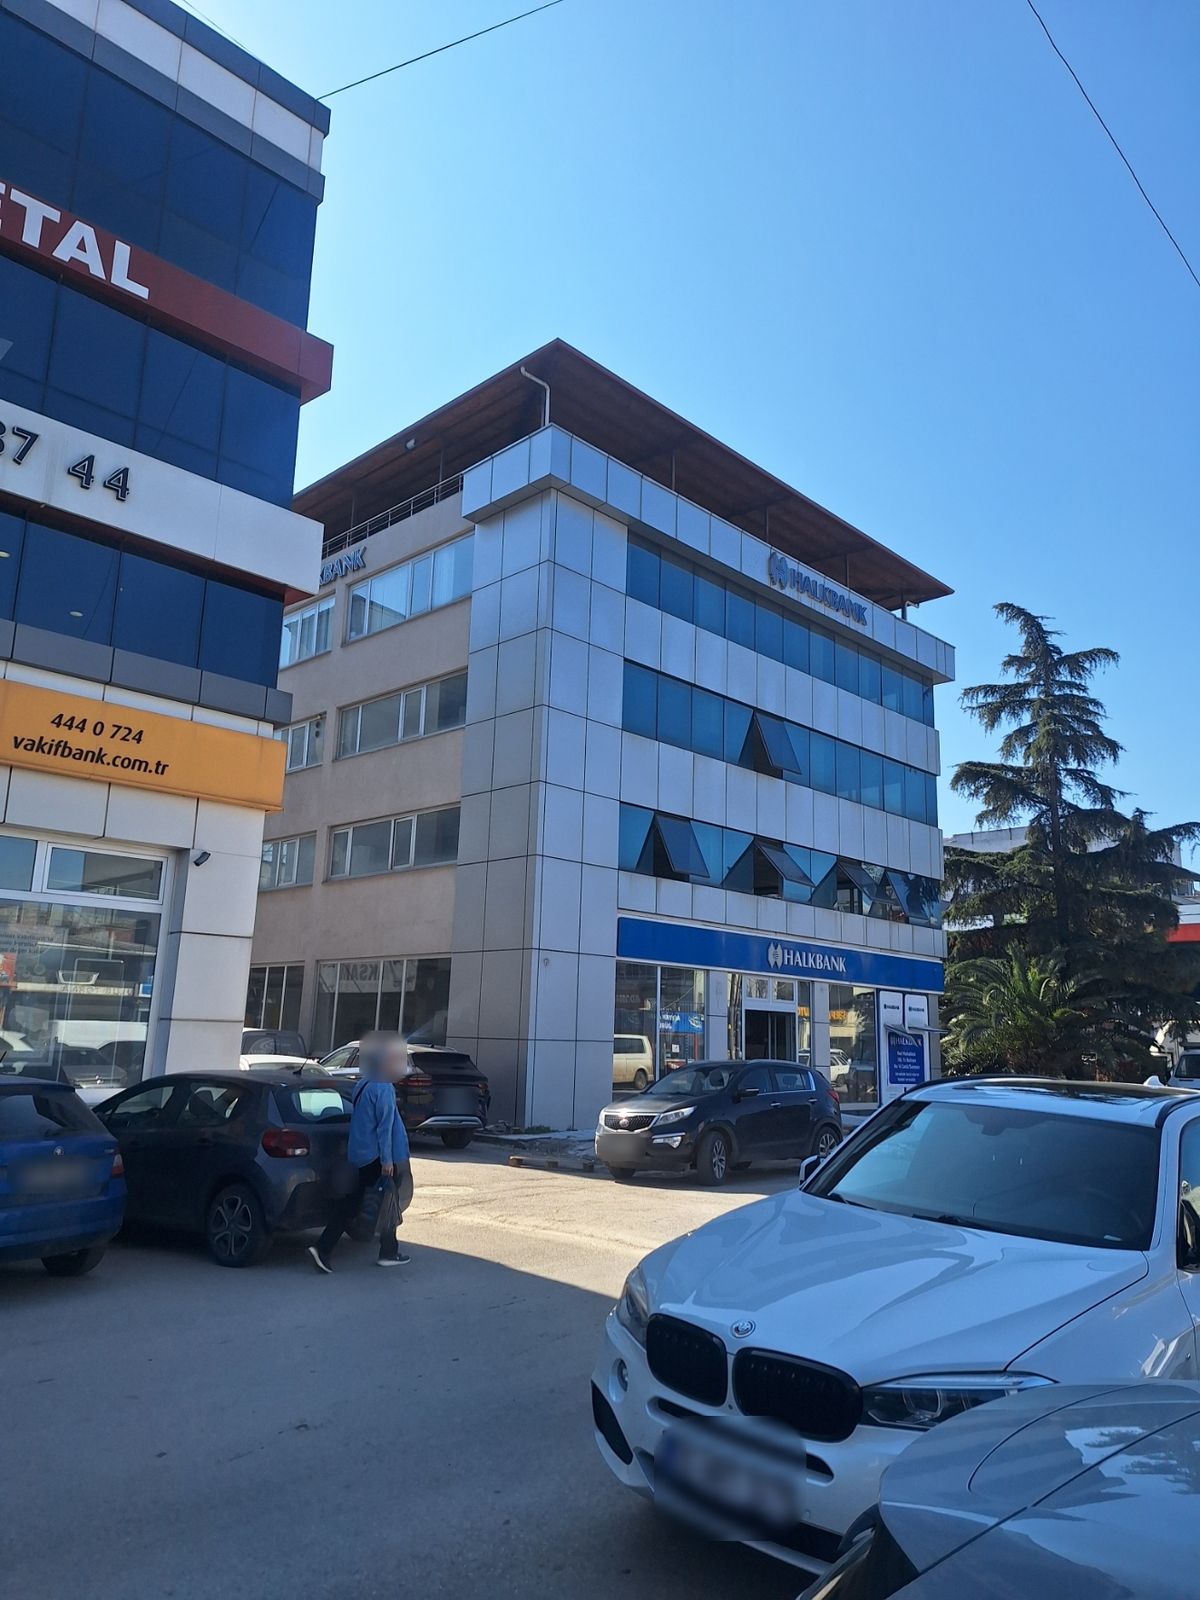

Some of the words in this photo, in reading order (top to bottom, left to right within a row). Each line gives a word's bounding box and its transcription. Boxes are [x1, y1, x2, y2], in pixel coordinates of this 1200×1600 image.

[0, 181, 149, 300] TAL
[0, 422, 39, 465] 7
[68, 454, 131, 501] 44
[789, 568, 868, 627] HALKBANK
[50, 713, 88, 733] 444
[92, 721, 105, 737] 0
[110, 724, 144, 745] 724
[13, 735, 169, 776] vakifbank.com.tr
[783, 949, 847, 973] HALKBANK
